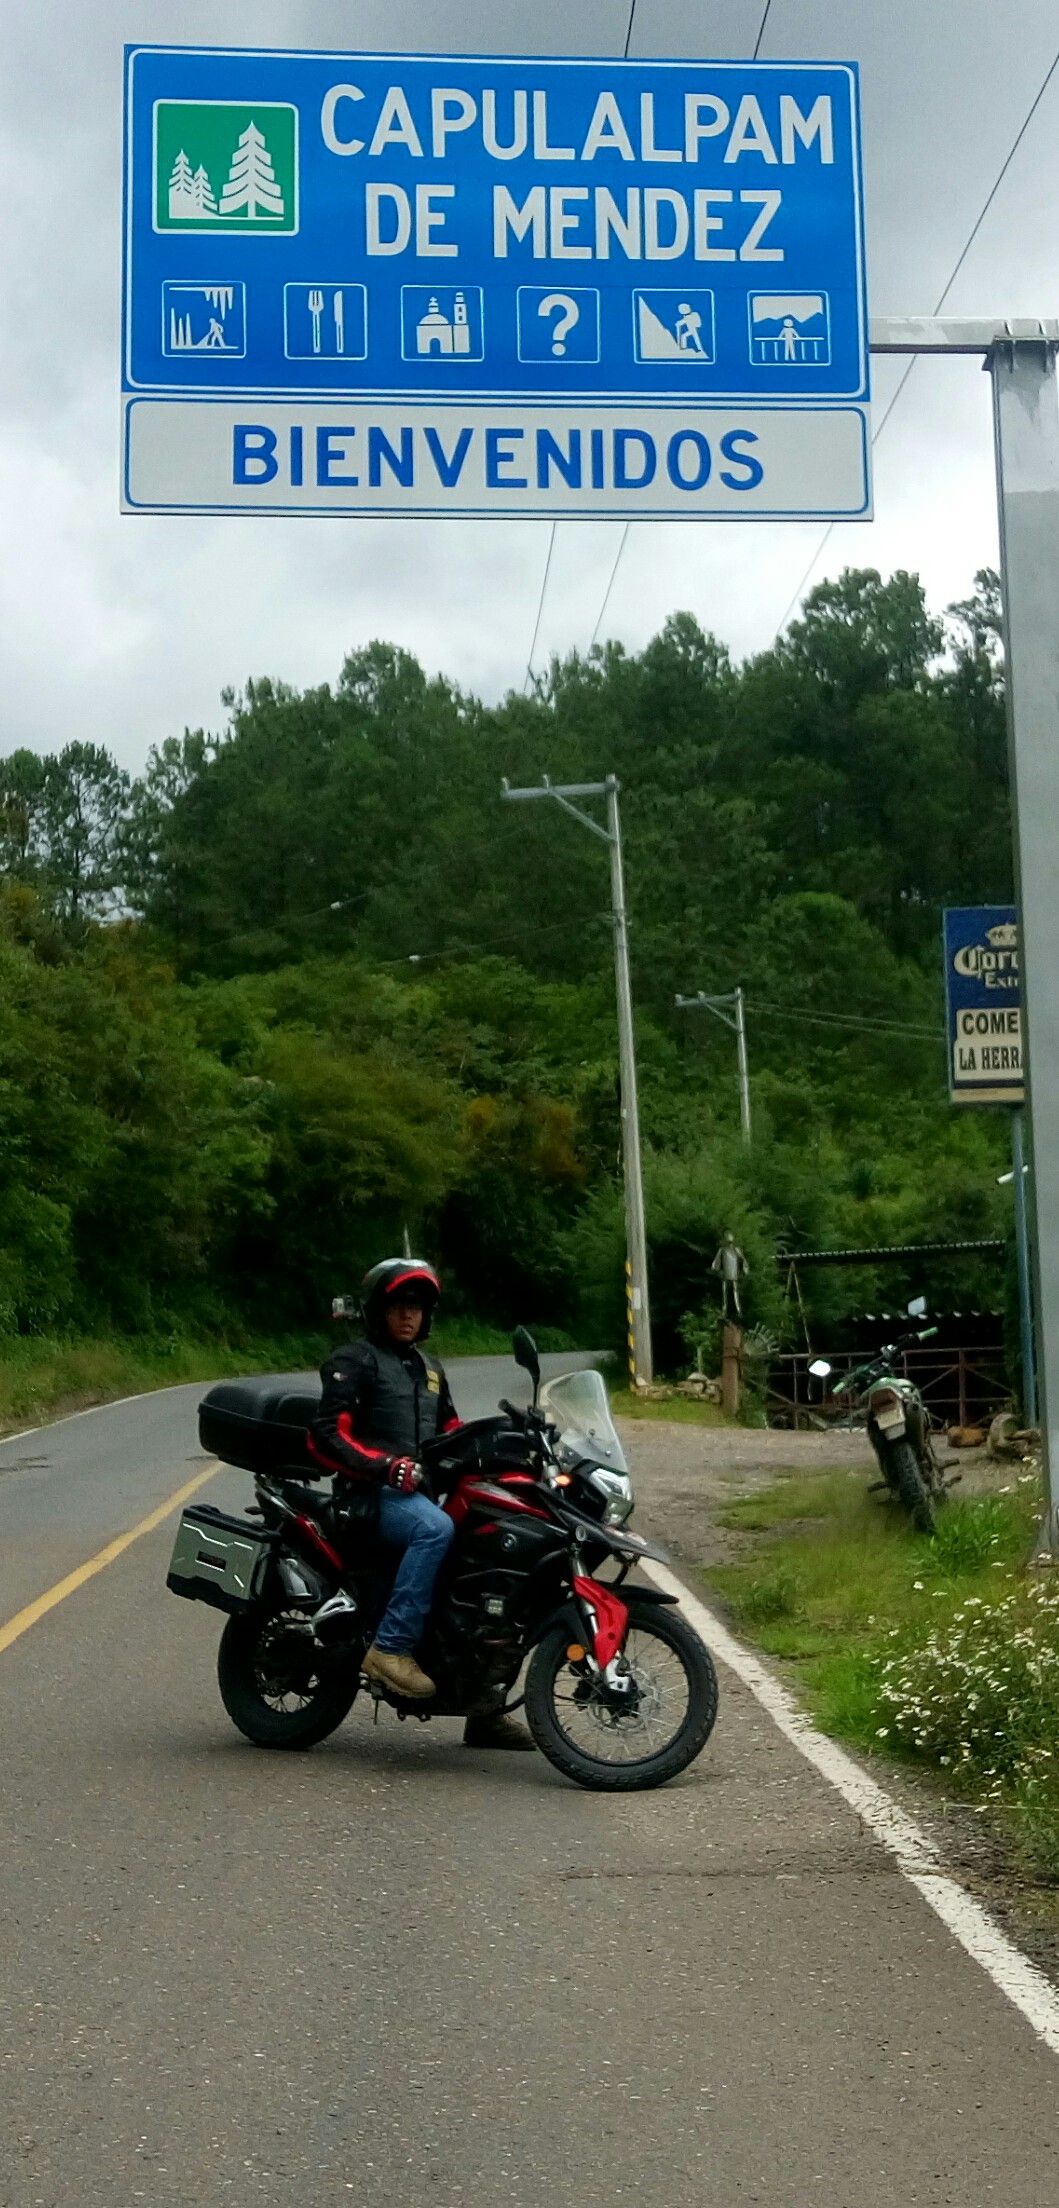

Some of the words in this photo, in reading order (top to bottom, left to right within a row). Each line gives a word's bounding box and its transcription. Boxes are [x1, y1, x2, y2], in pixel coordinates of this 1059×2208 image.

[321, 83, 835, 165] CAPULALPAM
[366, 182, 459, 257] DE
[493, 185, 785, 261] MENDEZ
[232, 424, 765, 491] BIENVENIDOS
[959, 1047, 977, 1071] LA
